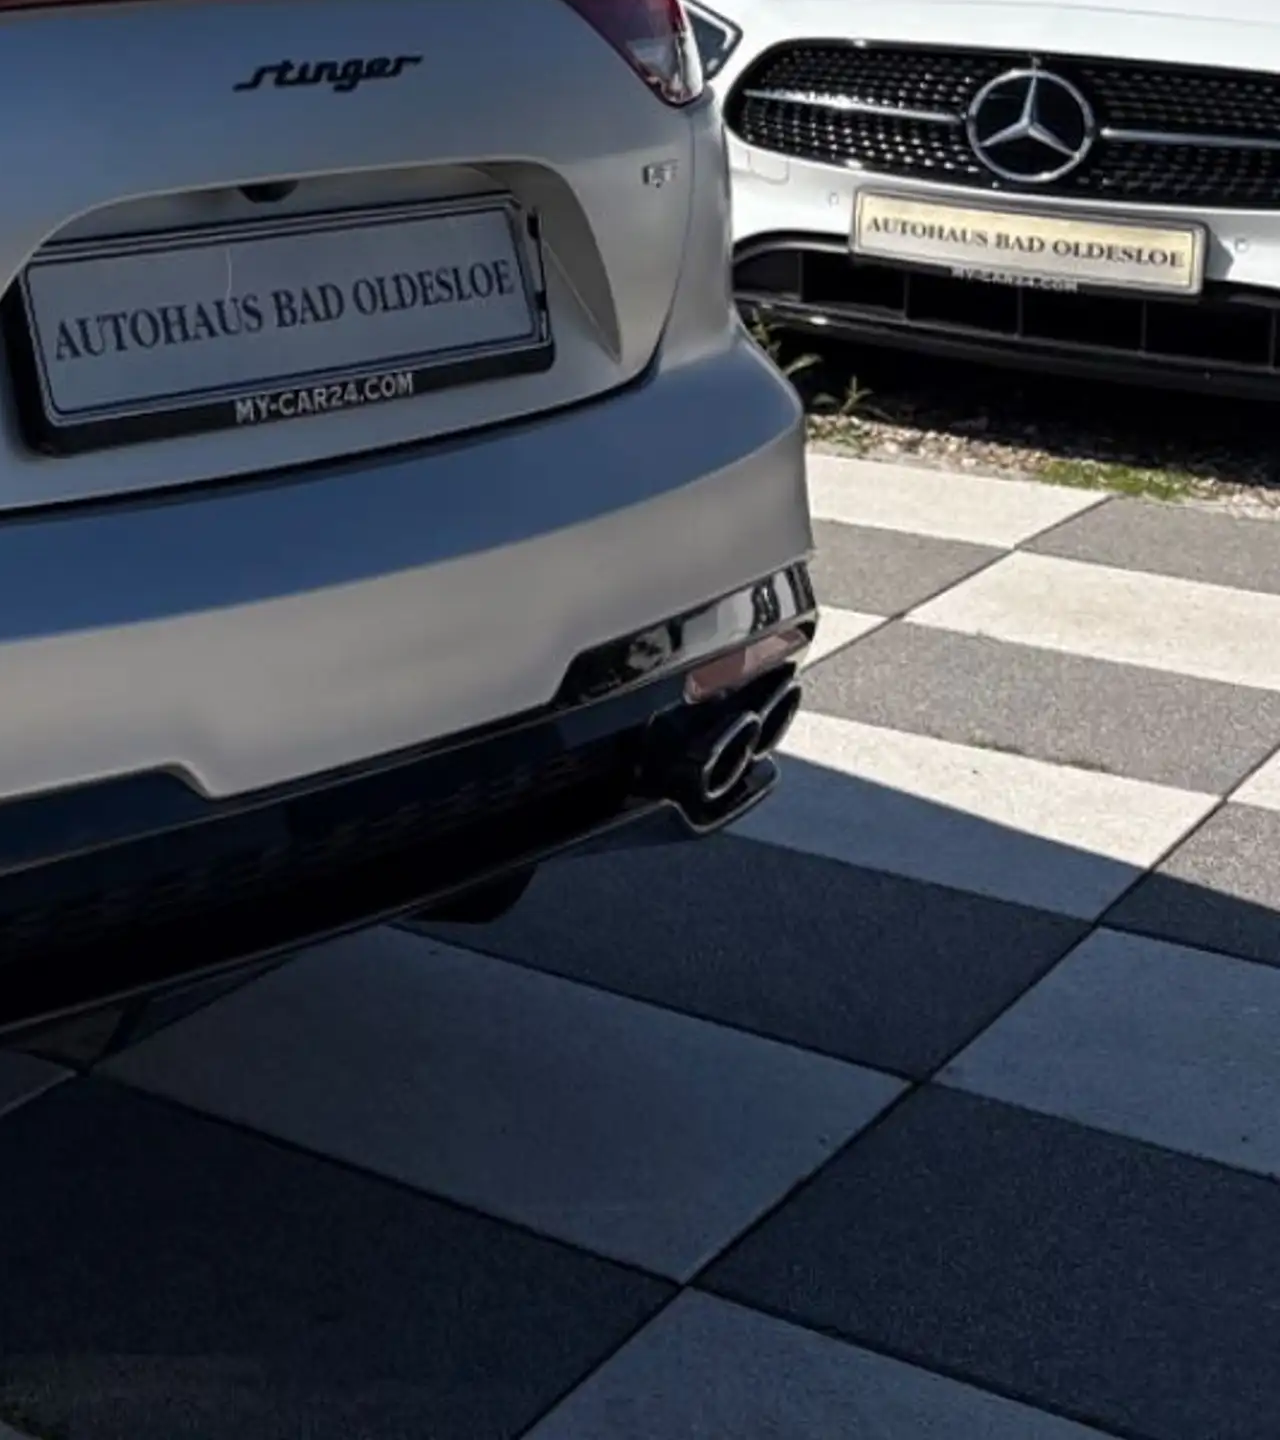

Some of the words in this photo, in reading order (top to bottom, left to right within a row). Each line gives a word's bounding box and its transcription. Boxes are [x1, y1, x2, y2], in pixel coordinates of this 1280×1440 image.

[232, 54, 424, 93] stinger
[866, 216, 989, 247] AUTOHAUS
[995, 232, 1046, 254] BAD
[1052, 237, 1186, 268] OLDESLOE
[54, 294, 265, 361] AUTOHAUS
[269, 282, 346, 330] BAD
[352, 259, 516, 316] OLDESLOE
[235, 372, 415, 424] MY-CAR24.COM
